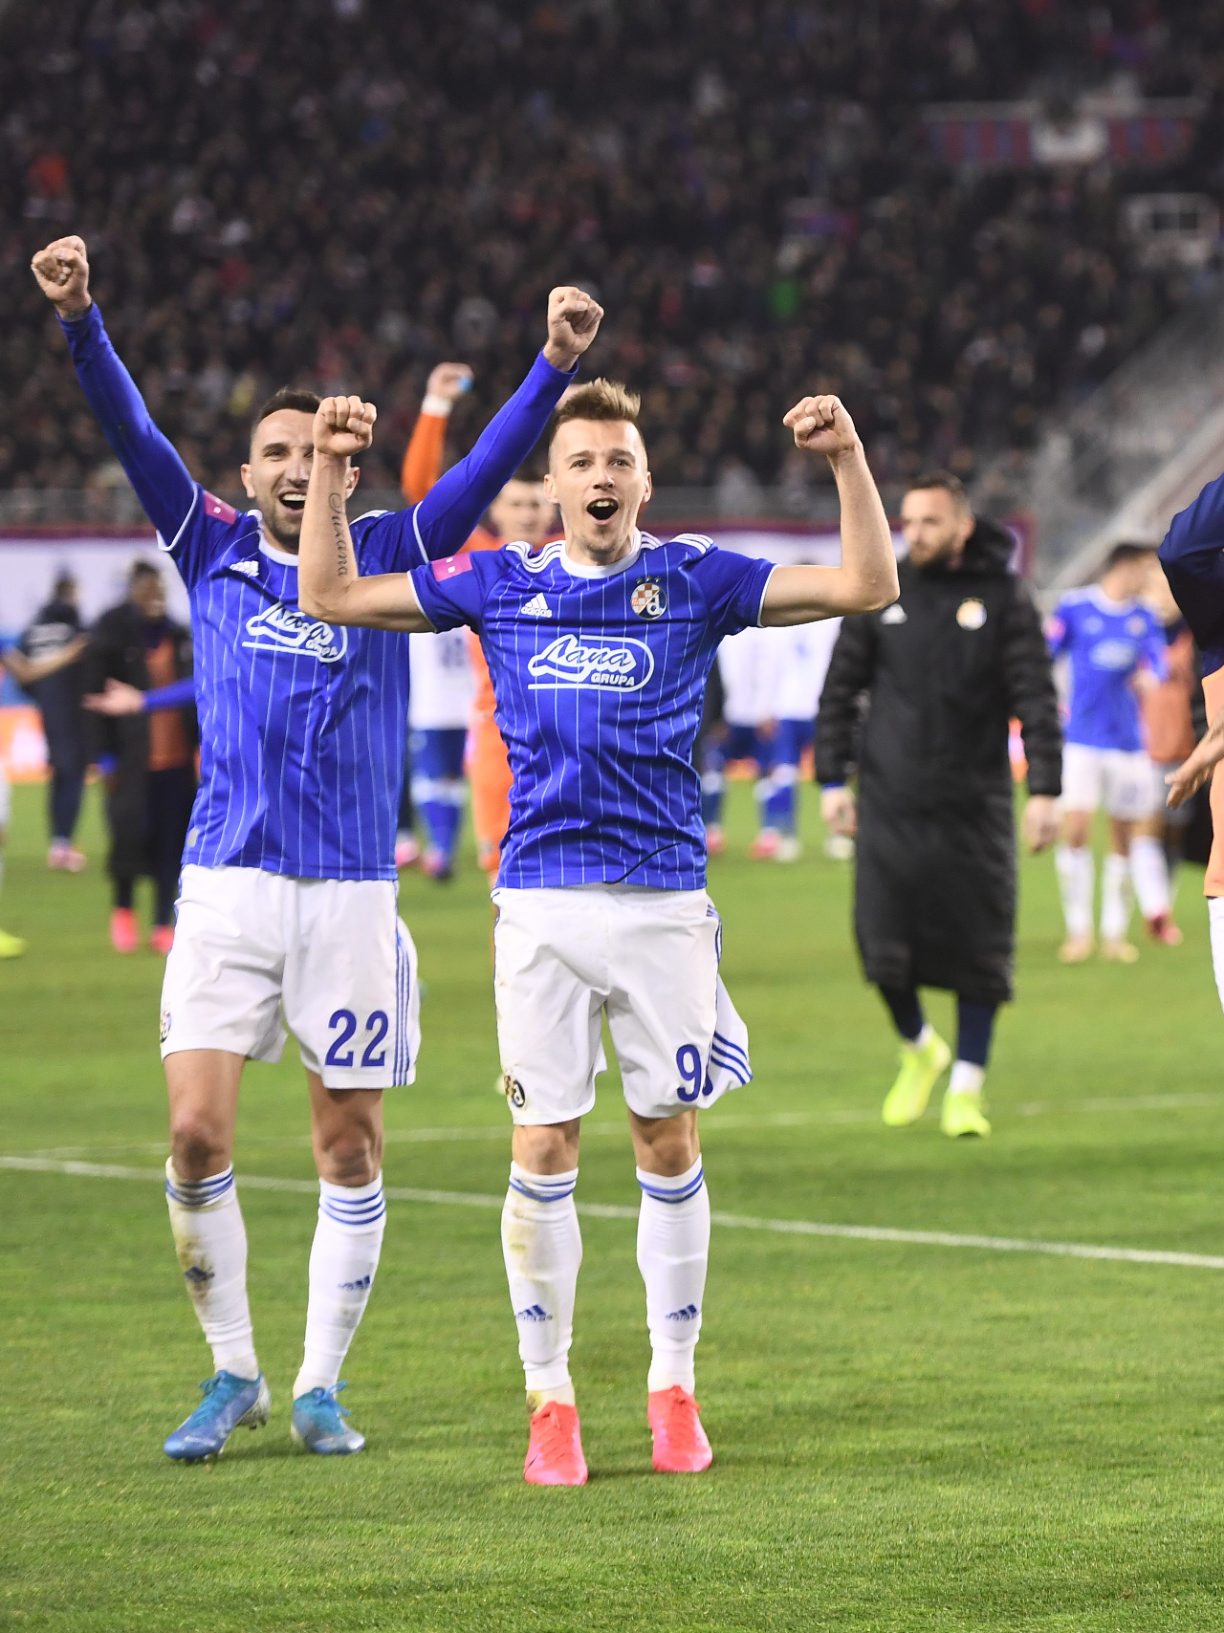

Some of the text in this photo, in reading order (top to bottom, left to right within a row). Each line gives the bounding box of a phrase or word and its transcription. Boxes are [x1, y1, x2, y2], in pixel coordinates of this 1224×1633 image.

[520, 606, 552, 618] adidas
[305, 639, 338, 657] GPA
[528, 634, 637, 683] Lana
[591, 673, 635, 687] GRUPA
[325, 1009, 388, 1067] 22
